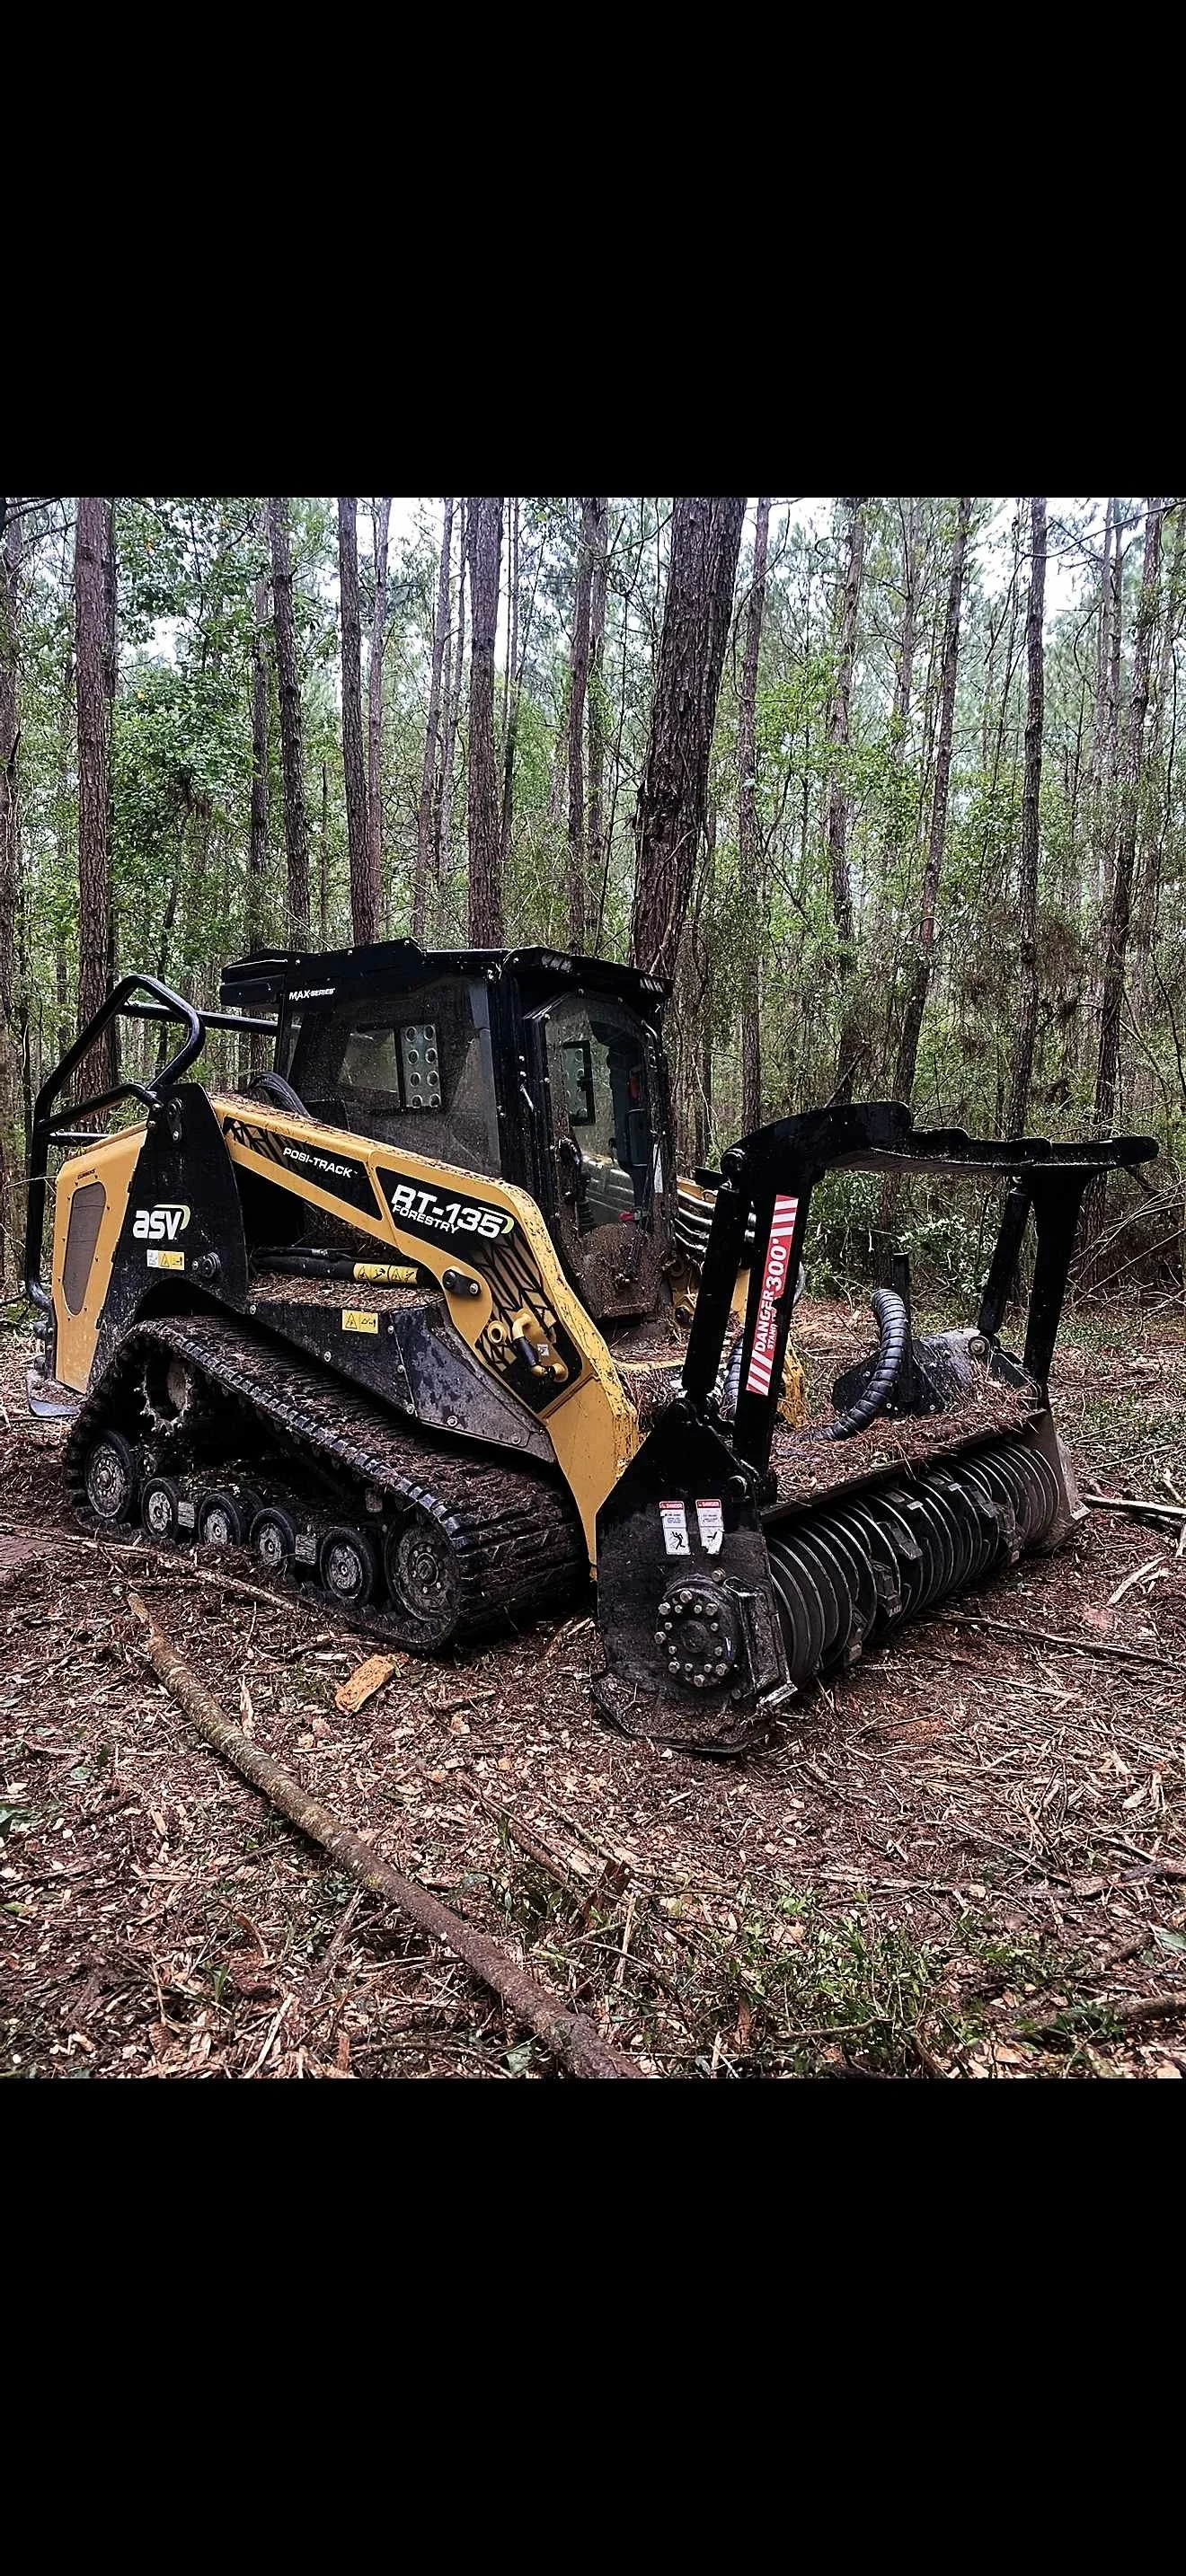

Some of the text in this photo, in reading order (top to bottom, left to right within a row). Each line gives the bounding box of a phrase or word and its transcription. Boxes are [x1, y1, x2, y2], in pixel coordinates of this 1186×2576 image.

[282, 1147, 353, 1178] POSI-TRACK
[391, 1184, 504, 1239] RT-135
[392, 1204, 461, 1234] FORESTRY
[754, 1290, 775, 1353] DANGER
